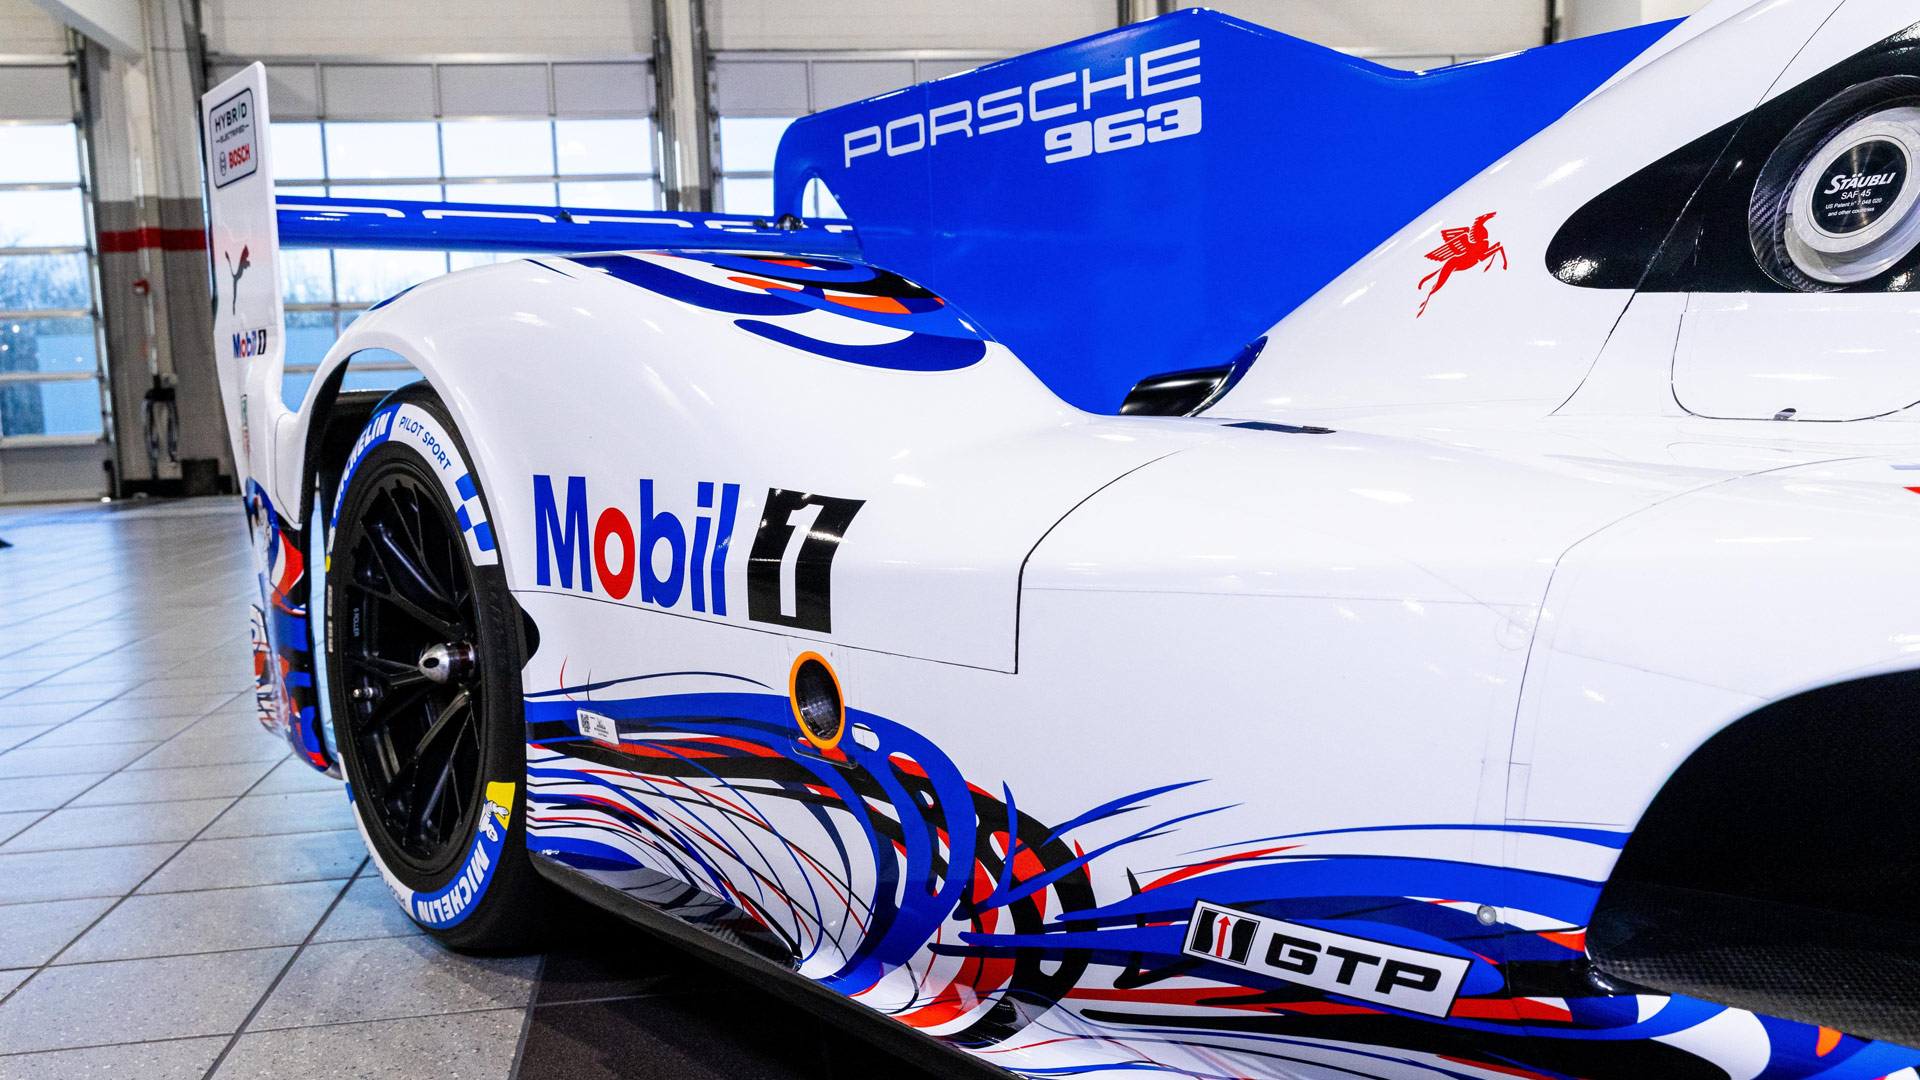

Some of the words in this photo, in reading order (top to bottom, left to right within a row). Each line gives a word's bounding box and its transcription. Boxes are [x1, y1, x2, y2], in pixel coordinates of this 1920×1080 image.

[215, 101, 247, 132] HYBRID
[844, 39, 1201, 168] PORSCHE
[1044, 96, 1202, 164] 963
[229, 143, 250, 169] BOSCH
[1841, 190, 1859, 200] SAF
[1860, 189, 1872, 197] 45
[232, 330, 257, 358] Mobil
[398, 415, 425, 437] PILOT
[421, 431, 452, 470] SPORT
[533, 474, 741, 617] Mobil
[417, 839, 491, 924] MICHELIN
[1264, 932, 1443, 995] GTP
